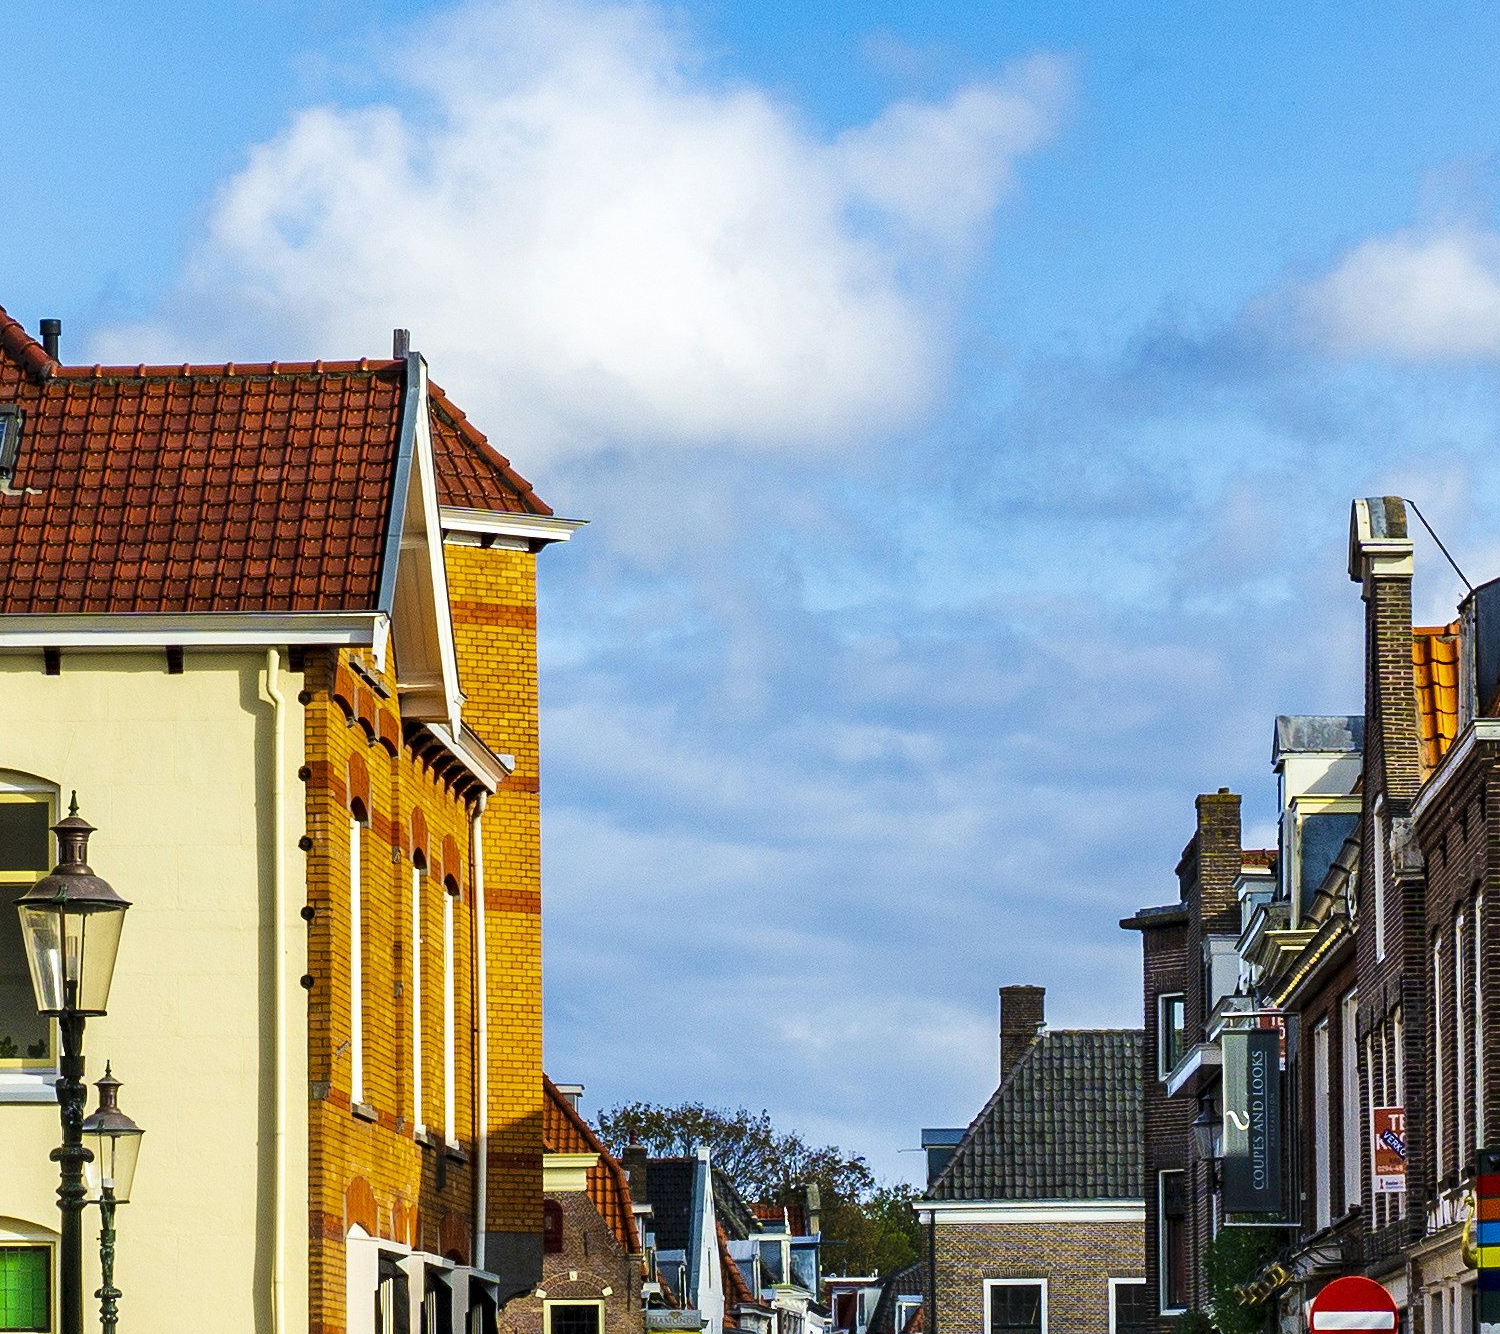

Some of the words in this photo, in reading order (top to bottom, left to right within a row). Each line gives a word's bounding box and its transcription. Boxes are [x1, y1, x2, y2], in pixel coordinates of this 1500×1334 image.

[1251, 1050, 1264, 1097] LOOKS
[1252, 1100, 1264, 1131] AND
[1252, 1134, 1265, 1190] COUPES
[1383, 1130, 1406, 1156] VERKO
